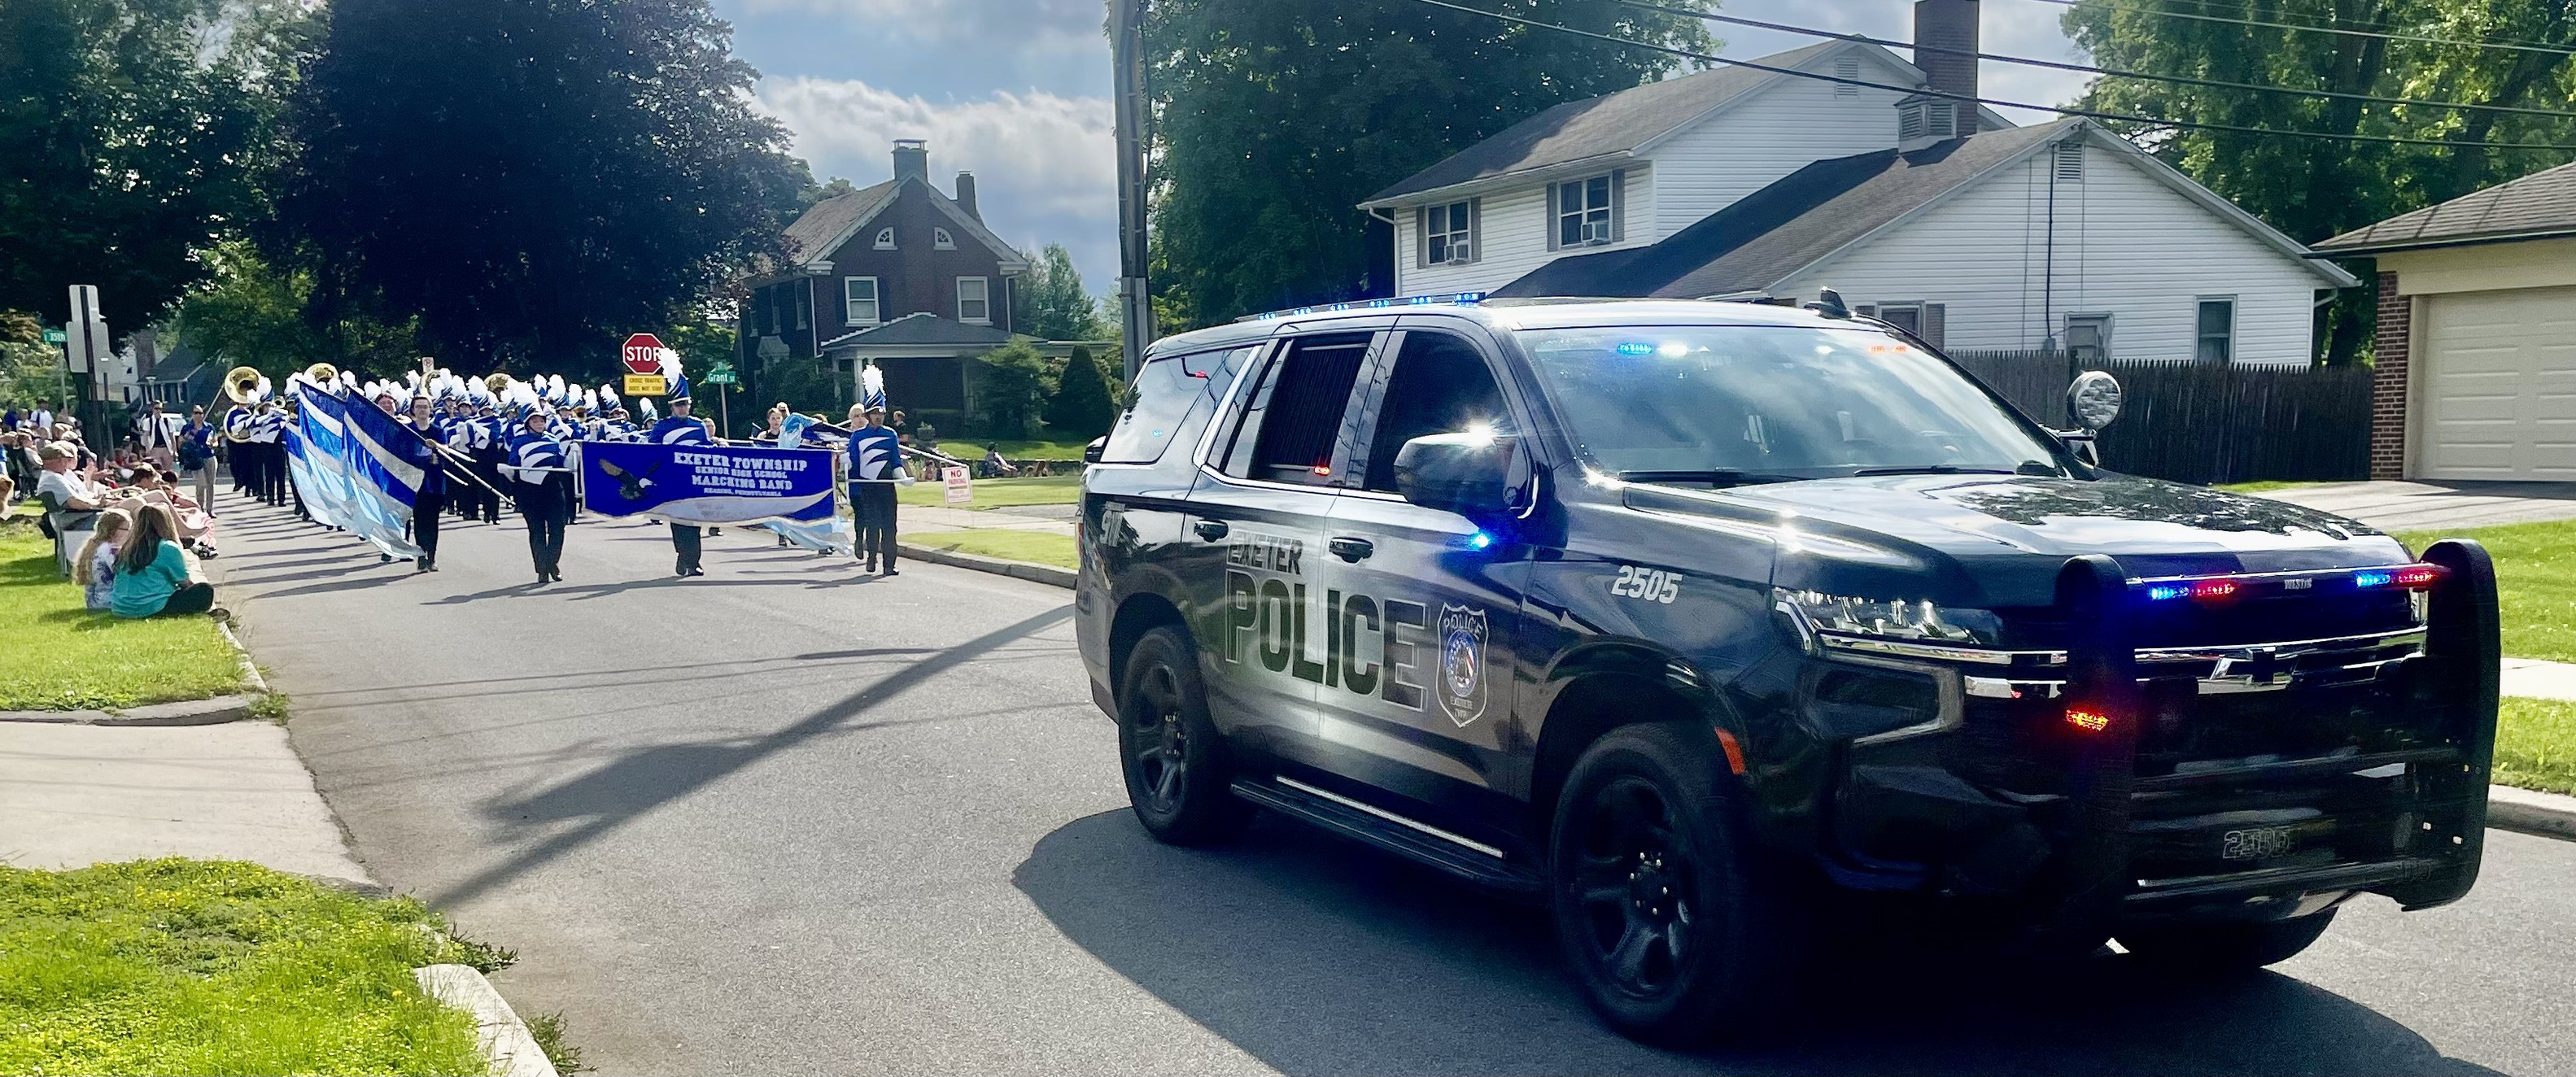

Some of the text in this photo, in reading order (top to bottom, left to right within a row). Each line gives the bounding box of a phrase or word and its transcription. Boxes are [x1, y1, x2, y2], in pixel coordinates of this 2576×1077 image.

[626, 346, 661, 362] STOP
[708, 373, 728, 382] Grant
[674, 451, 808, 472] EXETER TOWNSHIP
[695, 466, 788, 479] SENIOR HIGH SCHOOL
[950, 469, 963, 478] NO
[692, 474, 793, 491] MARCHING BAND
[1226, 529, 1303, 575] EXETER
[1610, 565, 1684, 604] 2505
[1443, 613, 1484, 642] POLICE
[1225, 568, 1432, 713] POLICE
